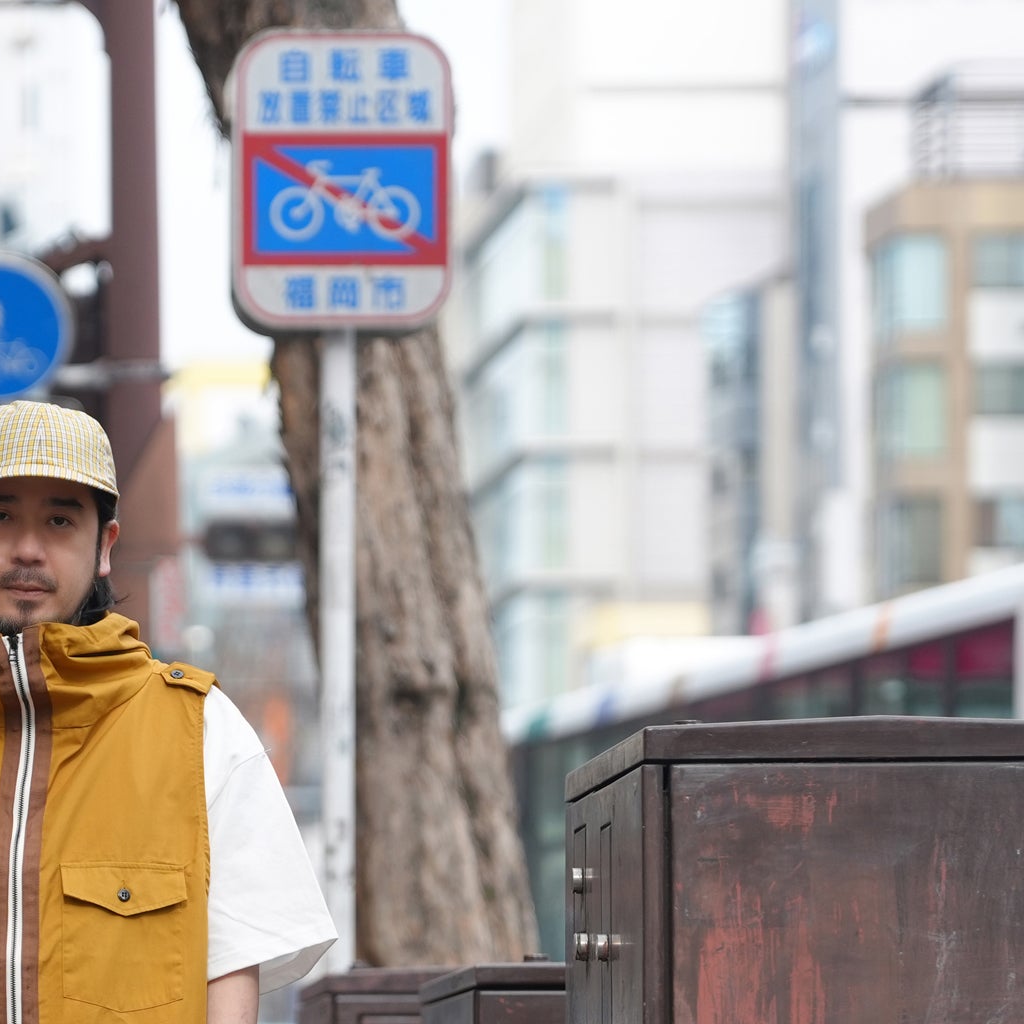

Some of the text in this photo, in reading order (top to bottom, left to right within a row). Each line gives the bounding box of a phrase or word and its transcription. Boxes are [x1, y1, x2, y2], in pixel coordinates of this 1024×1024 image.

[280, 49, 409, 82] 自転車
[260, 89, 431, 122] 放置禁止区域
[285, 276, 406, 309] 福岡市
